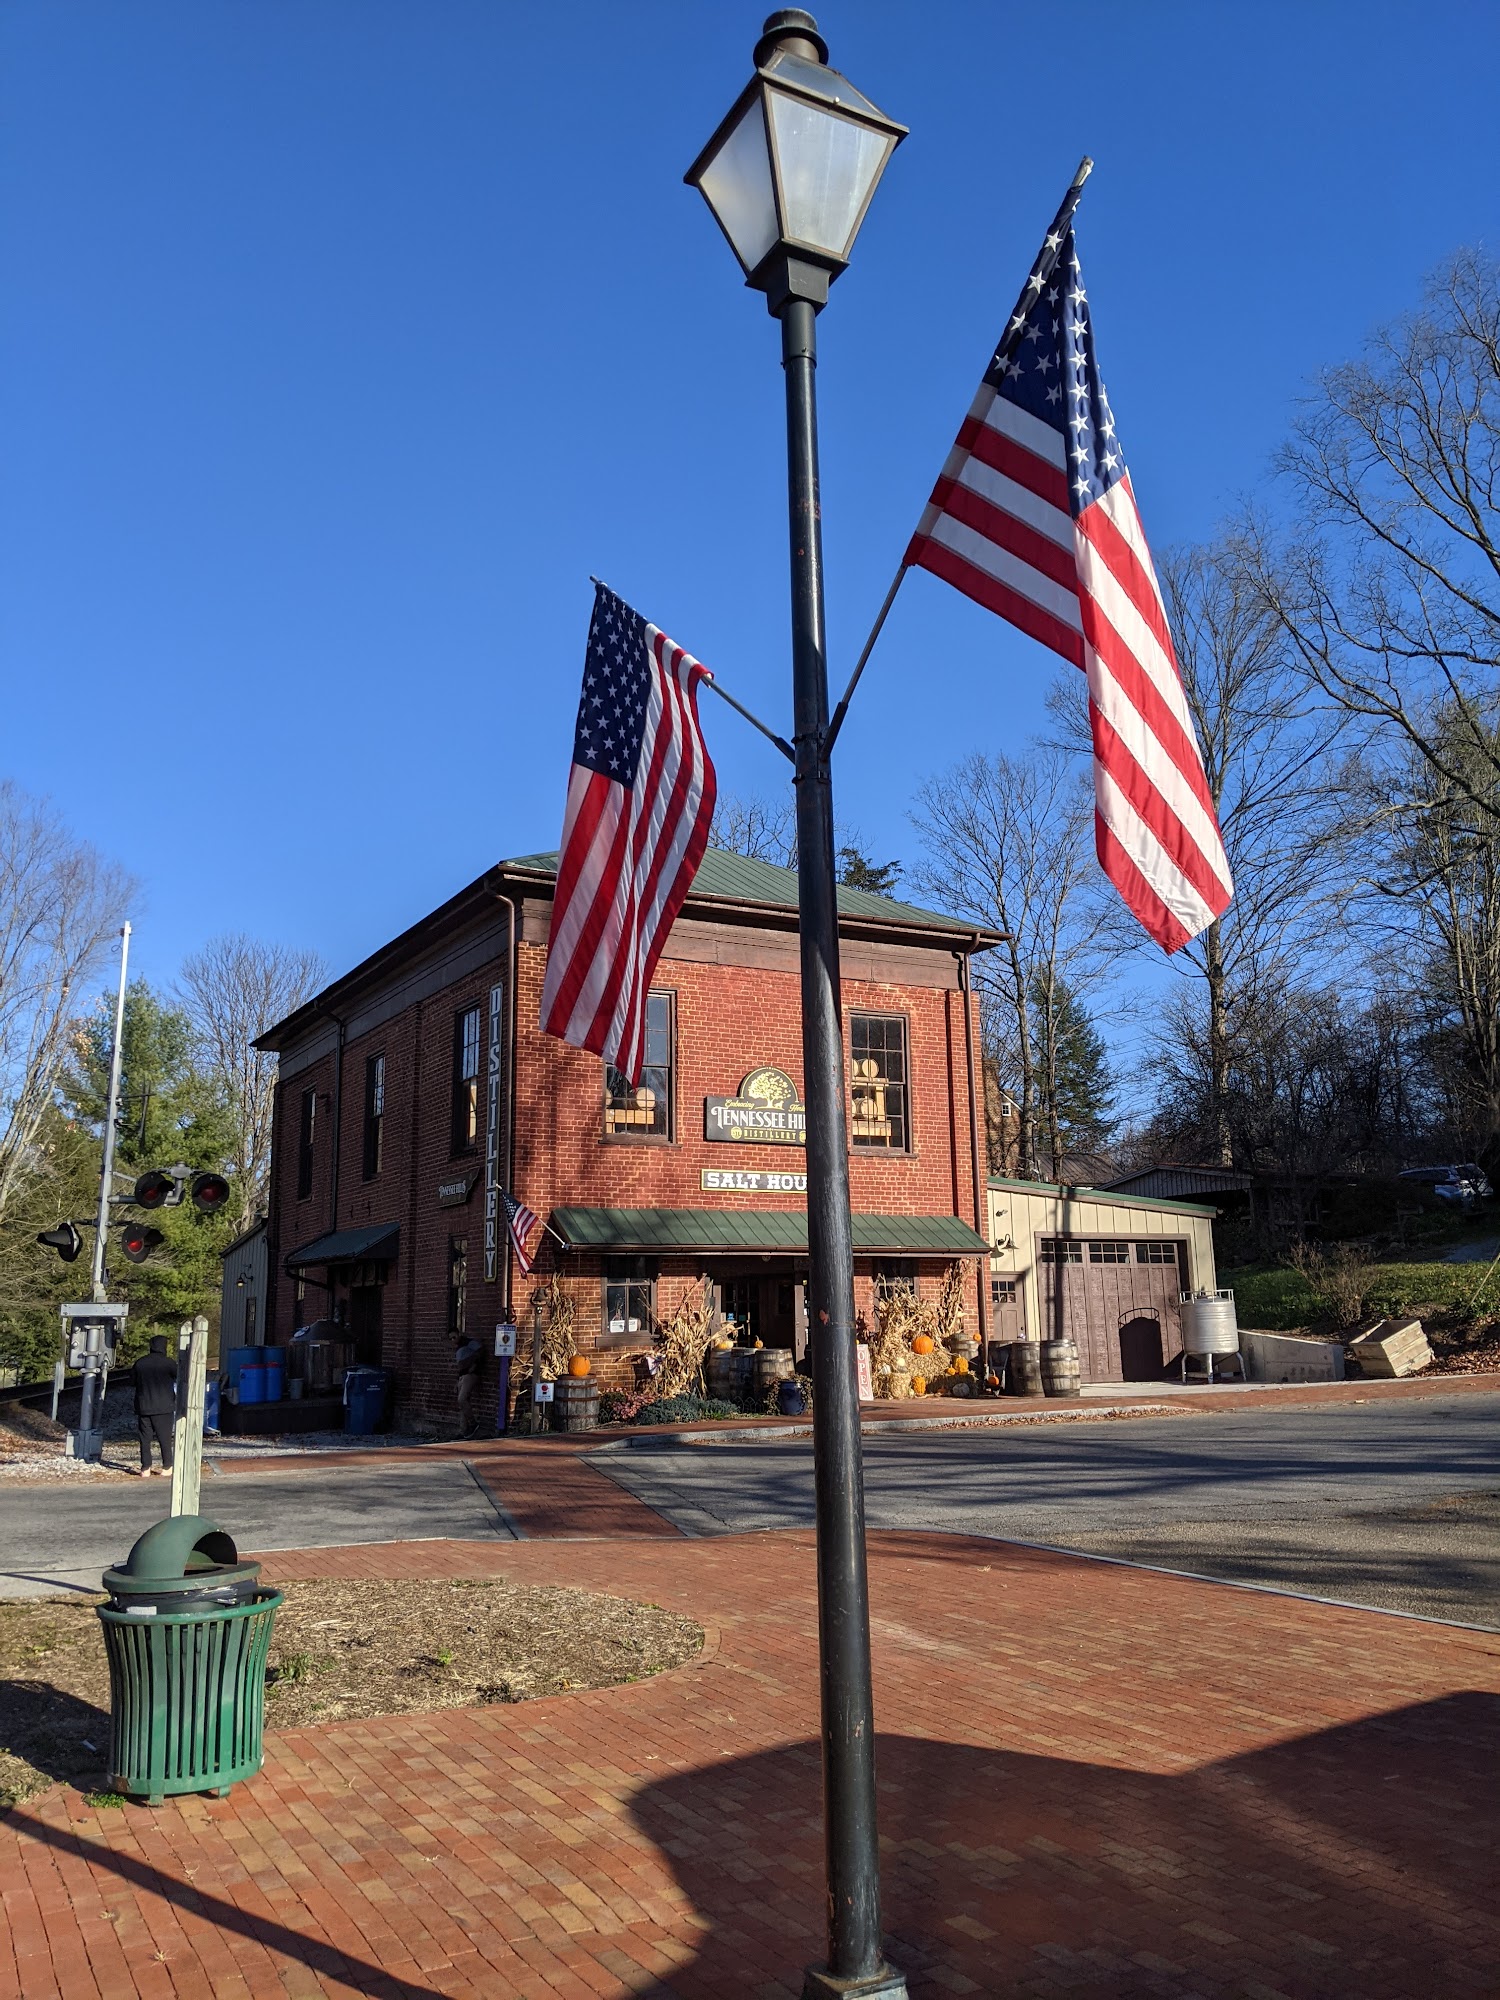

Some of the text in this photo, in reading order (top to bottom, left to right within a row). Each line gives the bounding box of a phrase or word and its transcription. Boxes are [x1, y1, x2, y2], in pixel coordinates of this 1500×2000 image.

[711, 1106, 787, 1129] TENNESSEE
[485, 988, 501, 1279] DISTILLERY
[743, 1129, 796, 1140] DISTILLERY
[707, 1172, 761, 1189] SALT
[857, 1351, 869, 1396] OPEN
